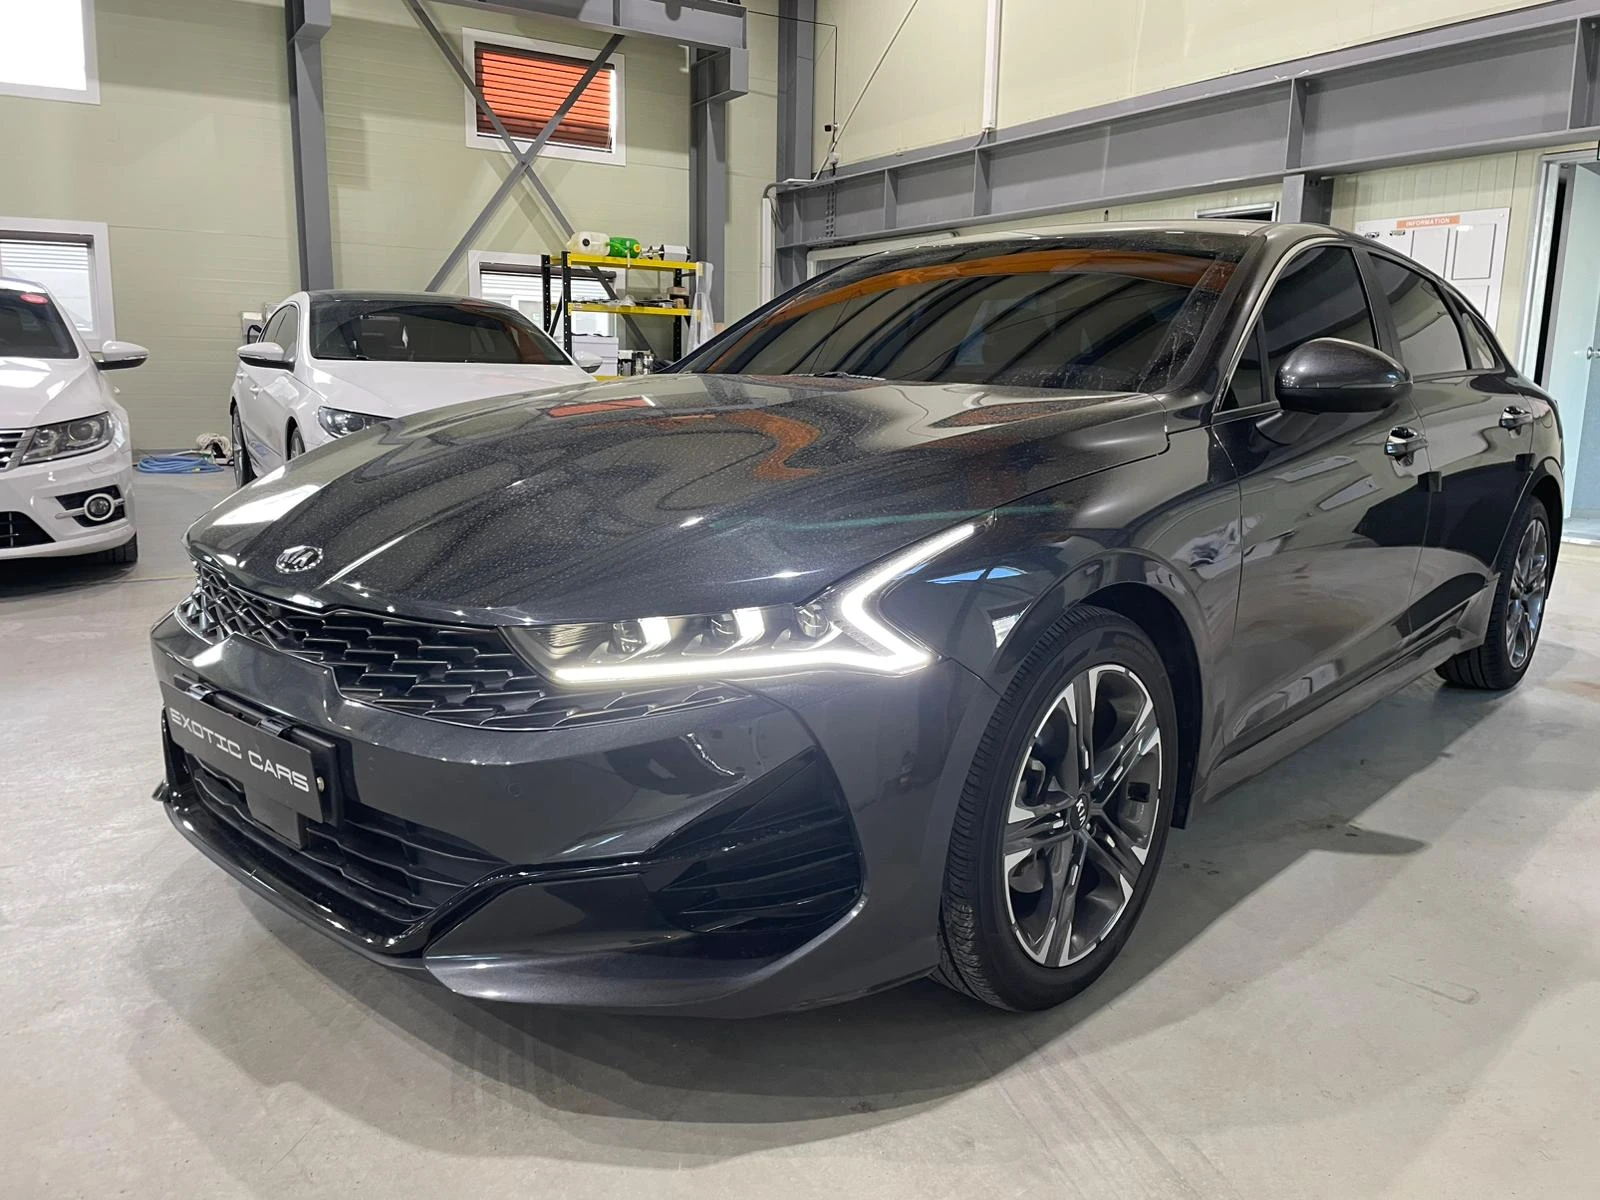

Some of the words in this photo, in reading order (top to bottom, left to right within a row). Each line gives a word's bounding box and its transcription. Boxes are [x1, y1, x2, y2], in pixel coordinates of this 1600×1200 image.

[1405, 217, 1451, 228] INFORMATION
[278, 547, 316, 569] KIA
[169, 707, 242, 760] EXOTIC
[247, 750, 310, 793] CARS
[1075, 797, 1087, 827] KIA
